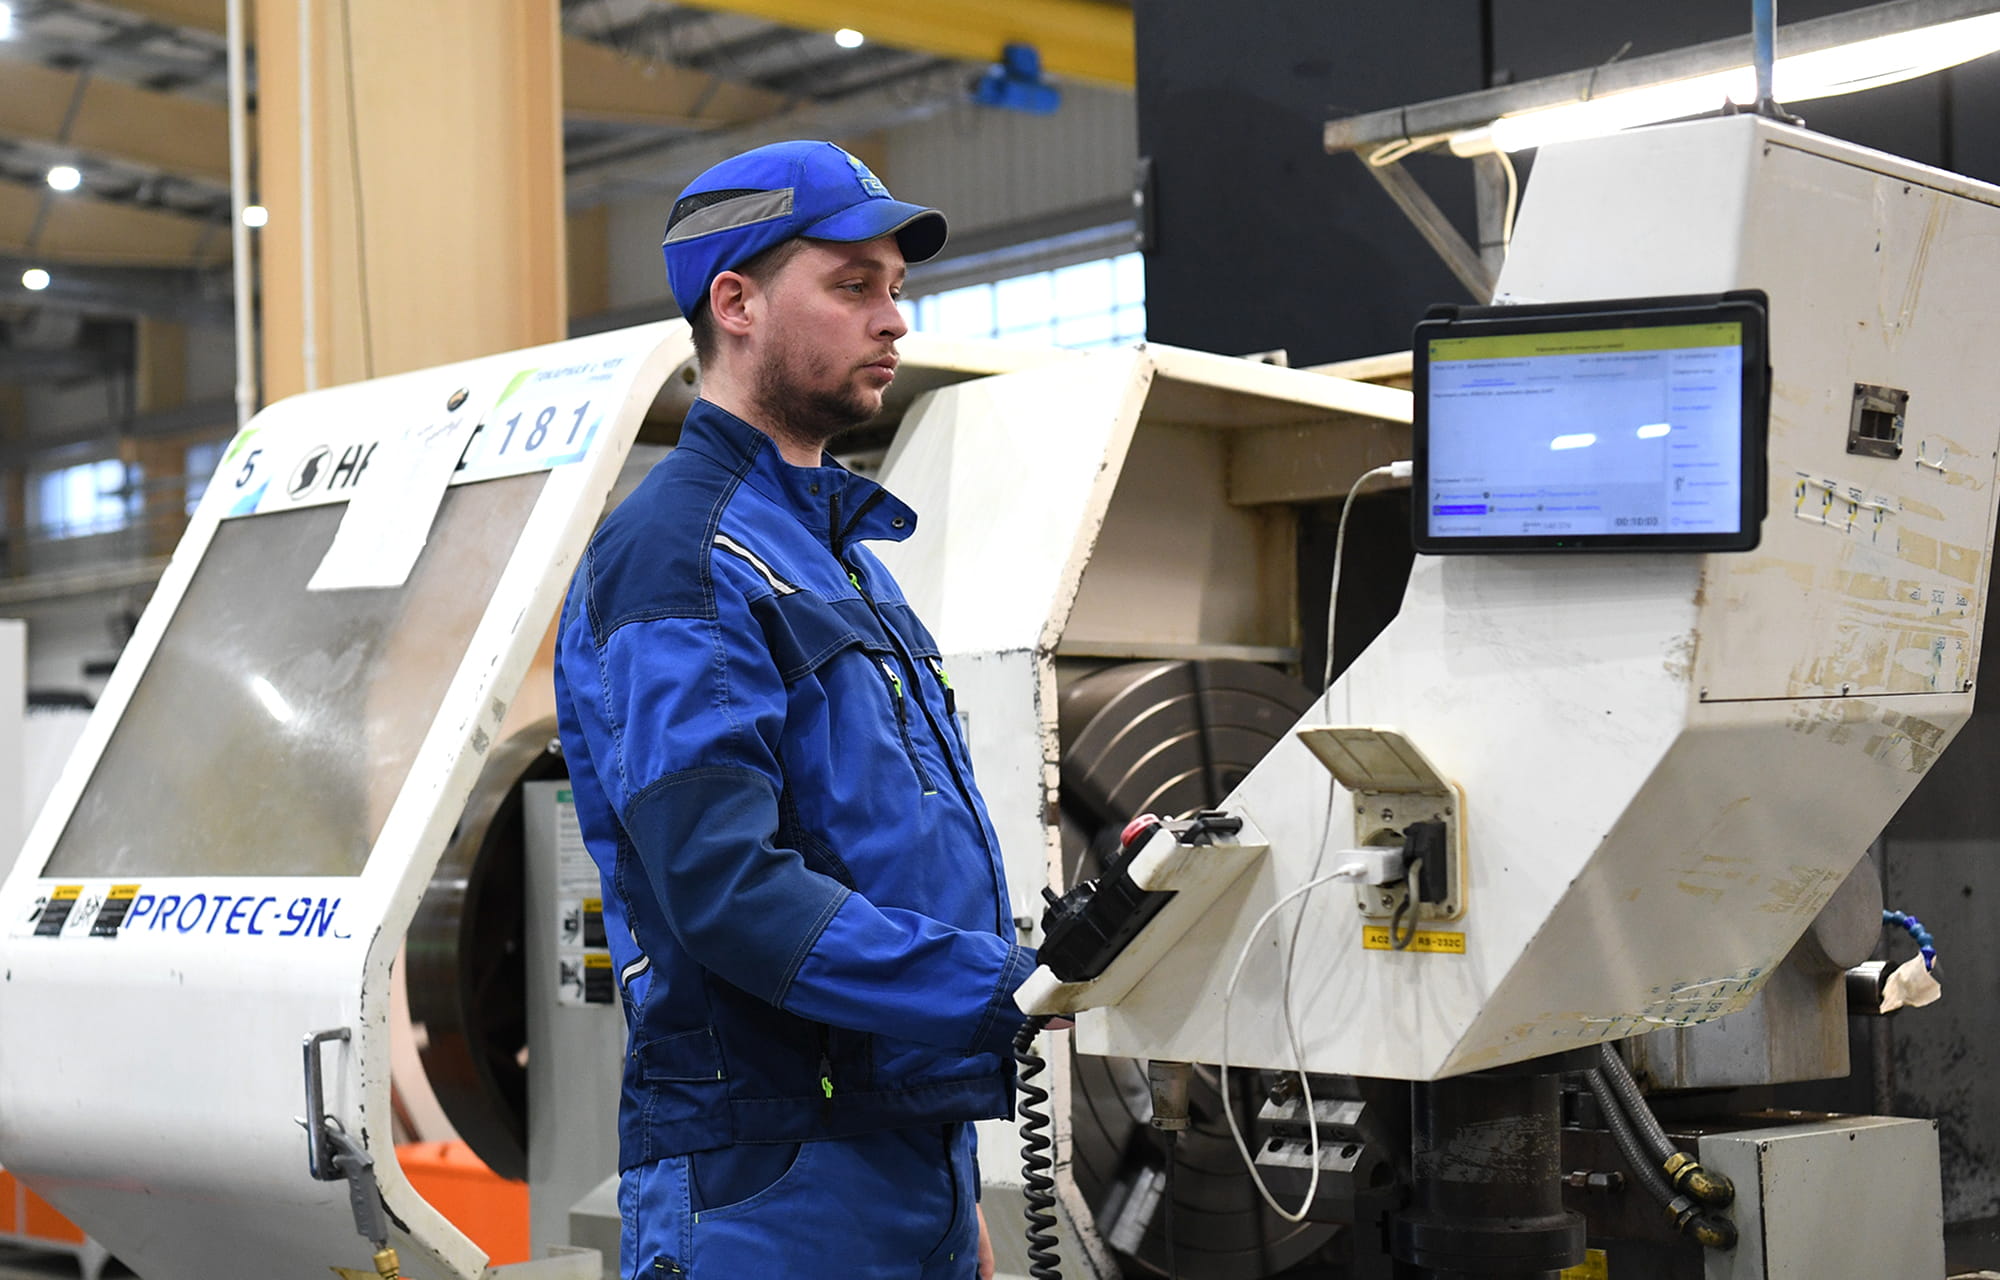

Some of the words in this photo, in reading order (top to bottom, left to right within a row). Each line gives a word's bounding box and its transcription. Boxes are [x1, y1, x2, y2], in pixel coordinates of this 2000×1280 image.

[498, 400, 591, 456] 181
[235, 449, 262, 488] 5
[125, 893, 351, 938] PROTEC-9N
